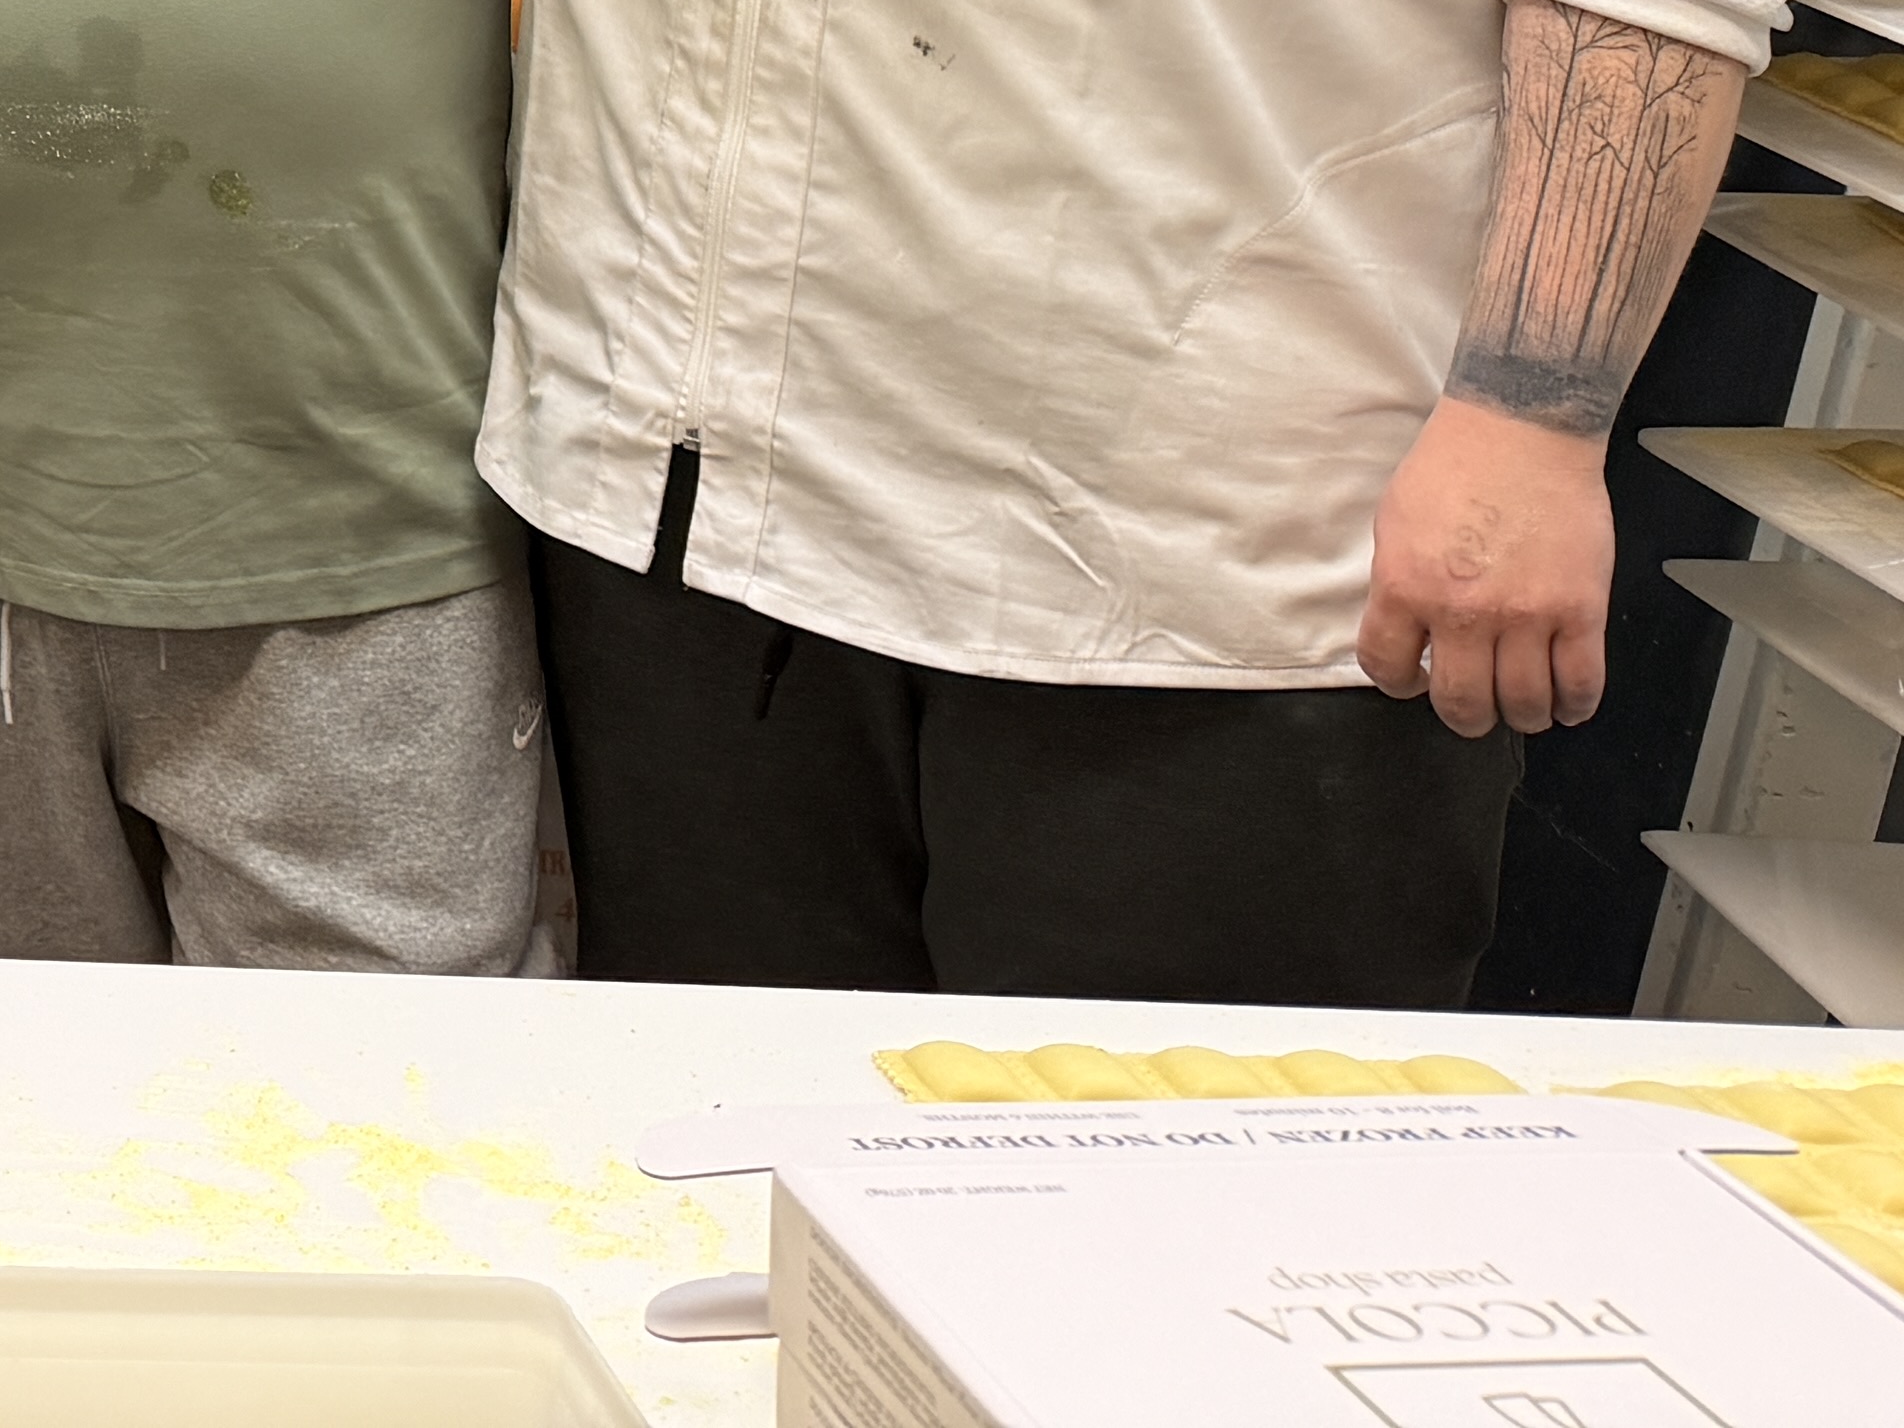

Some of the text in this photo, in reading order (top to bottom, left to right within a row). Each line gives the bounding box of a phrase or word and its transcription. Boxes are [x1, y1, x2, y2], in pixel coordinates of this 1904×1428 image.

[846, 1124, 1582, 1152] KEEP FROZEN DO NOT DEFROST
[1265, 1261, 1515, 1298] pasta shop
[1223, 1298, 1650, 1345] PICCOLA
